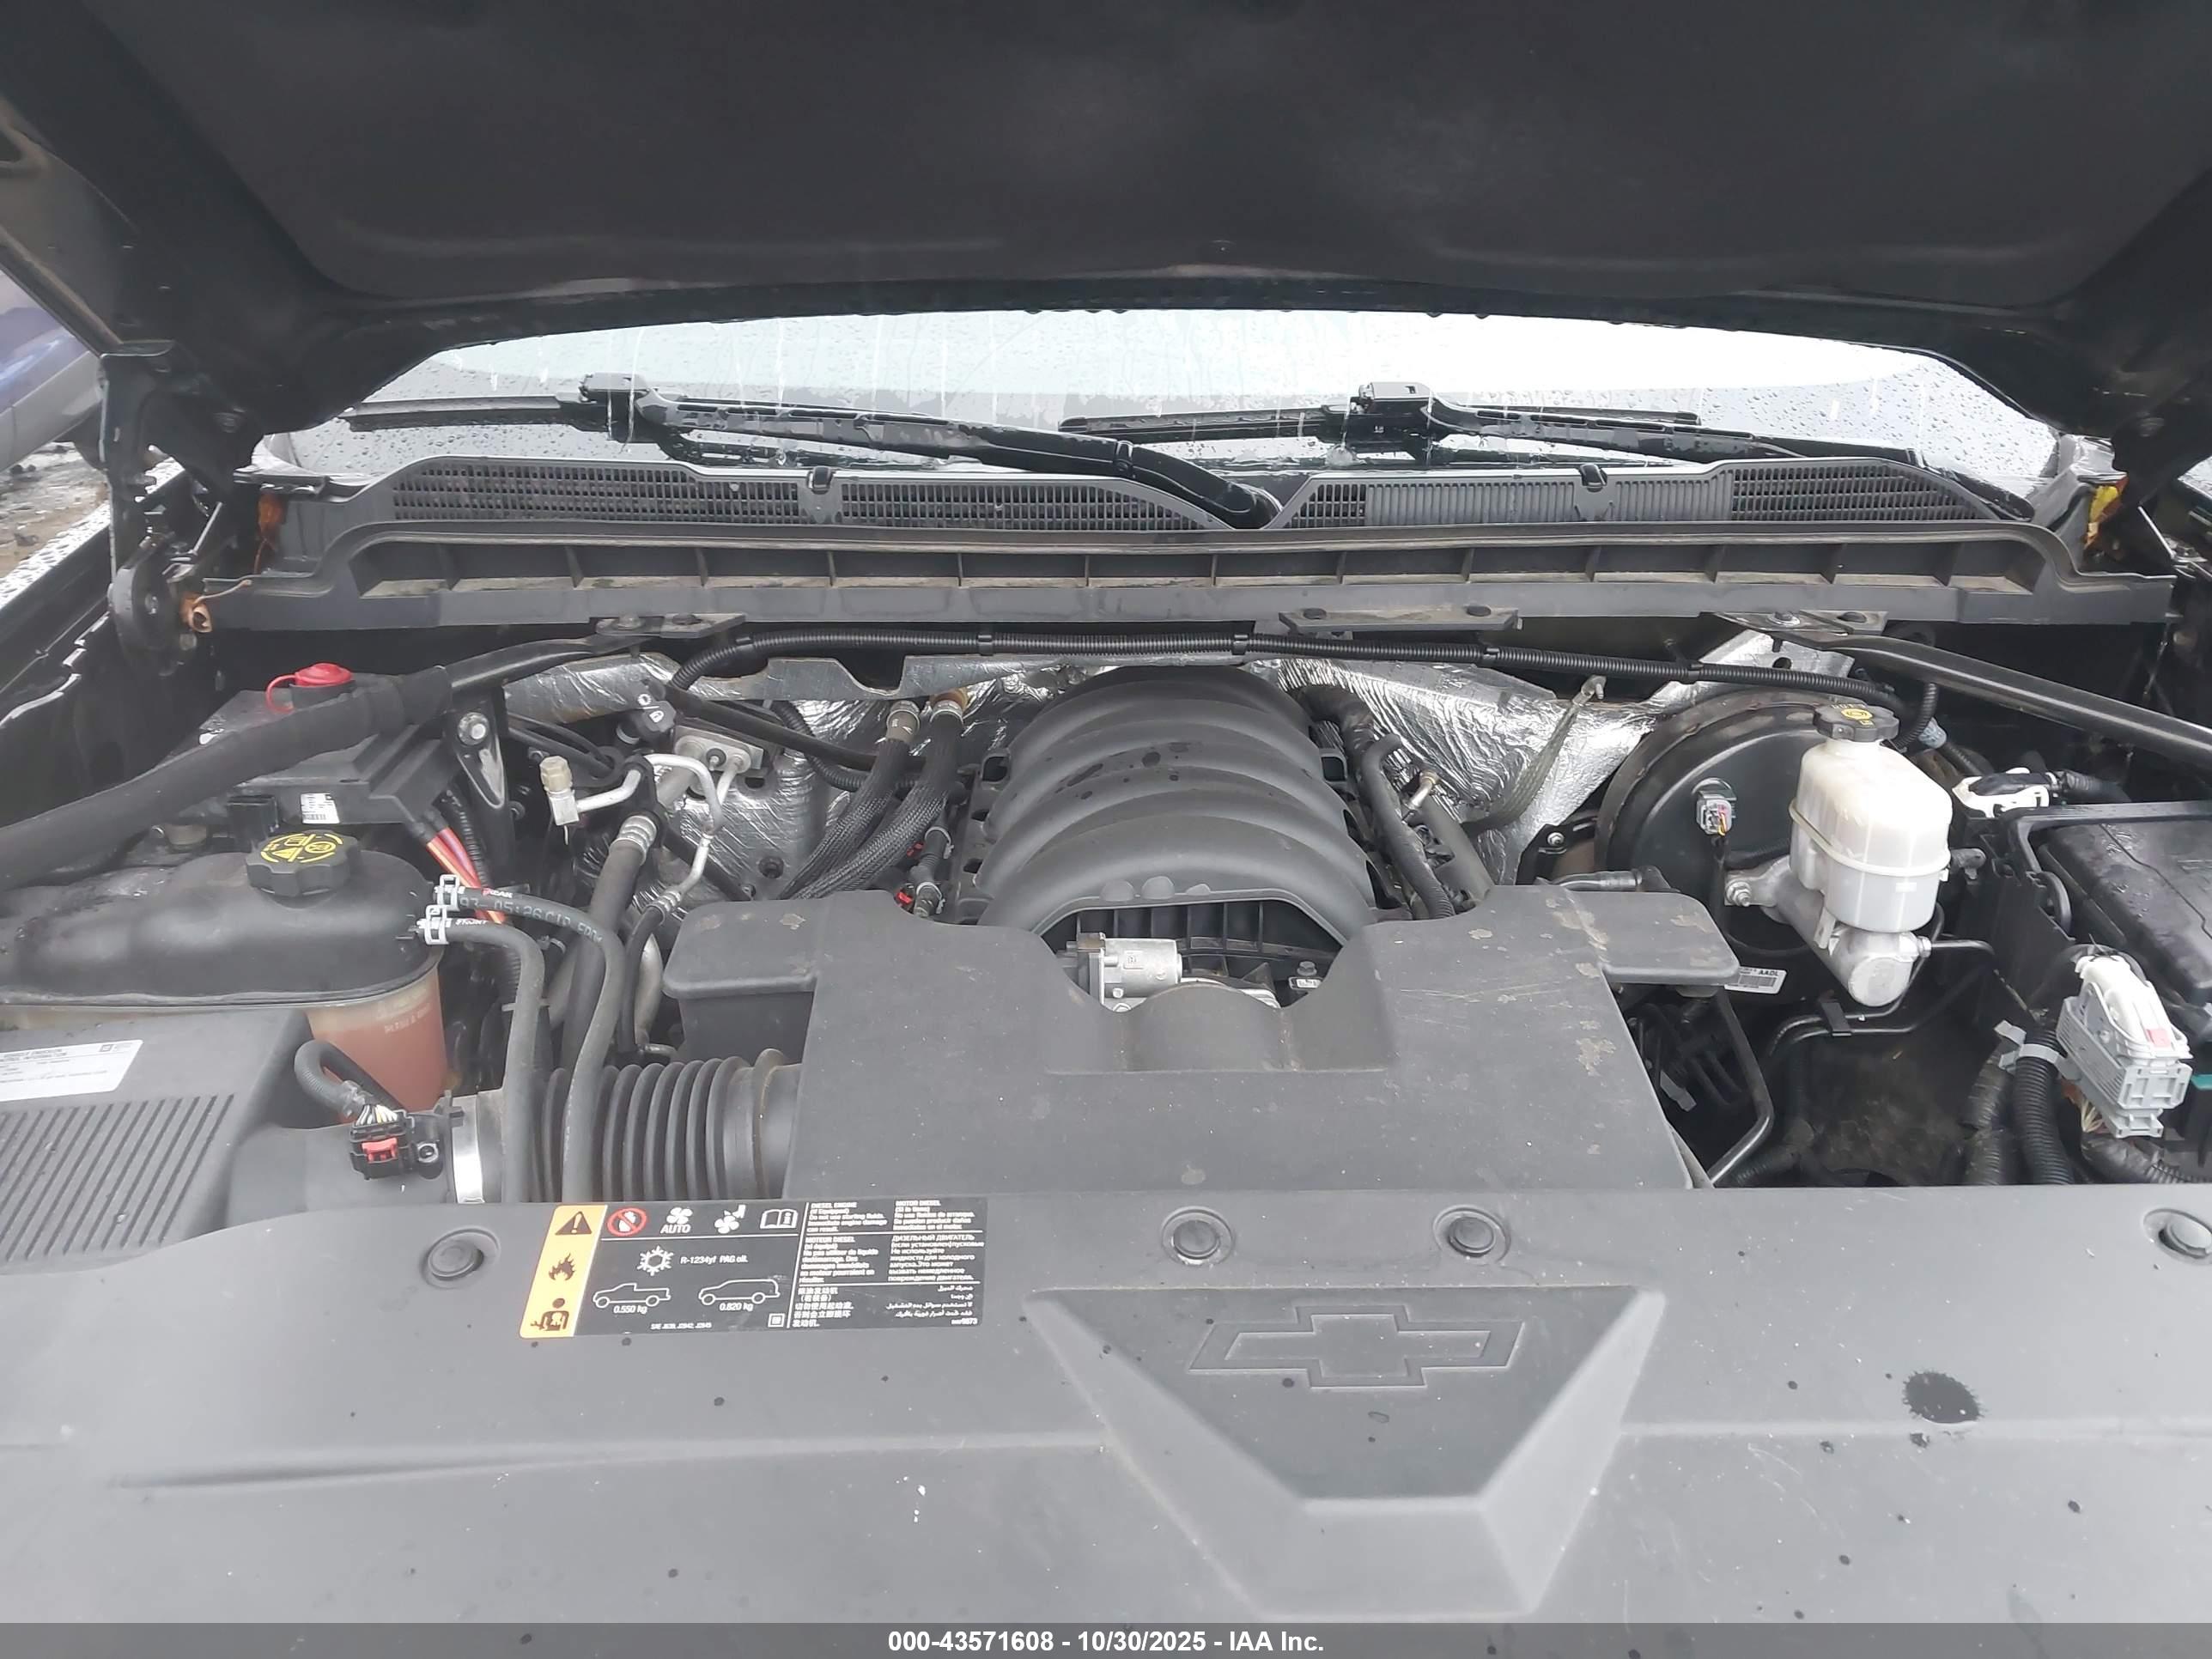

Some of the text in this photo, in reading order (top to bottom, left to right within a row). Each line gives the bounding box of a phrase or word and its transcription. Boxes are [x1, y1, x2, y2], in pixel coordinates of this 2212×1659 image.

[660, 1224, 691, 1234] AUTO
[680, 1255, 716, 1264] R-1234yf
[720, 1255, 735, 1263] PAG
[637, 1305, 647, 1314] kg
[743, 1303, 753, 1311] kg
